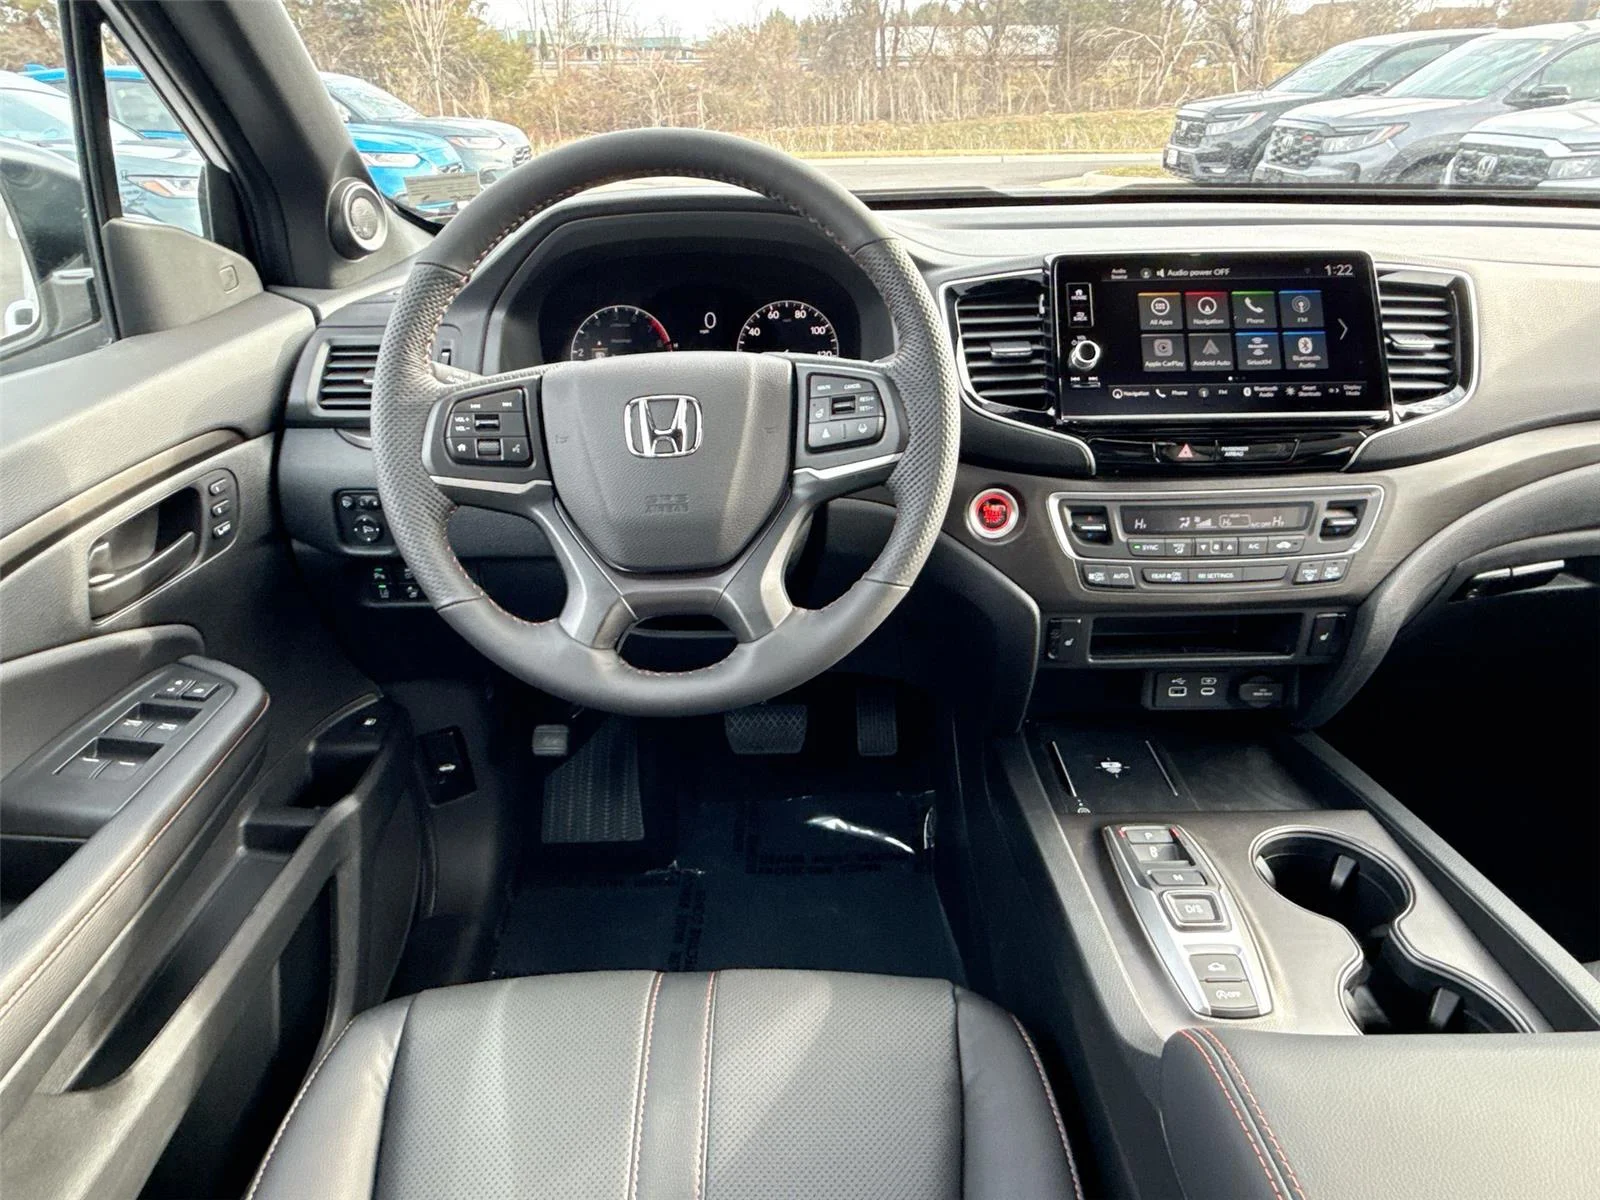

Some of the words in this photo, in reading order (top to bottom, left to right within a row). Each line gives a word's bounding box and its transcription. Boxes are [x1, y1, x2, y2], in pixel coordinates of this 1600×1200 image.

[1190, 269, 1212, 277] power
[1214, 268, 1230, 276] OFF
[1324, 264, 1353, 276] 1:22
[768, 310, 780, 320] 60
[794, 310, 806, 319] 80
[704, 312, 716, 329] 0
[1193, 318, 1224, 326] Navigation
[748, 328, 761, 336] 40
[810, 326, 826, 335] 100
[578, 348, 584, 357] 2
[1184, 905, 1203, 913] D/S
